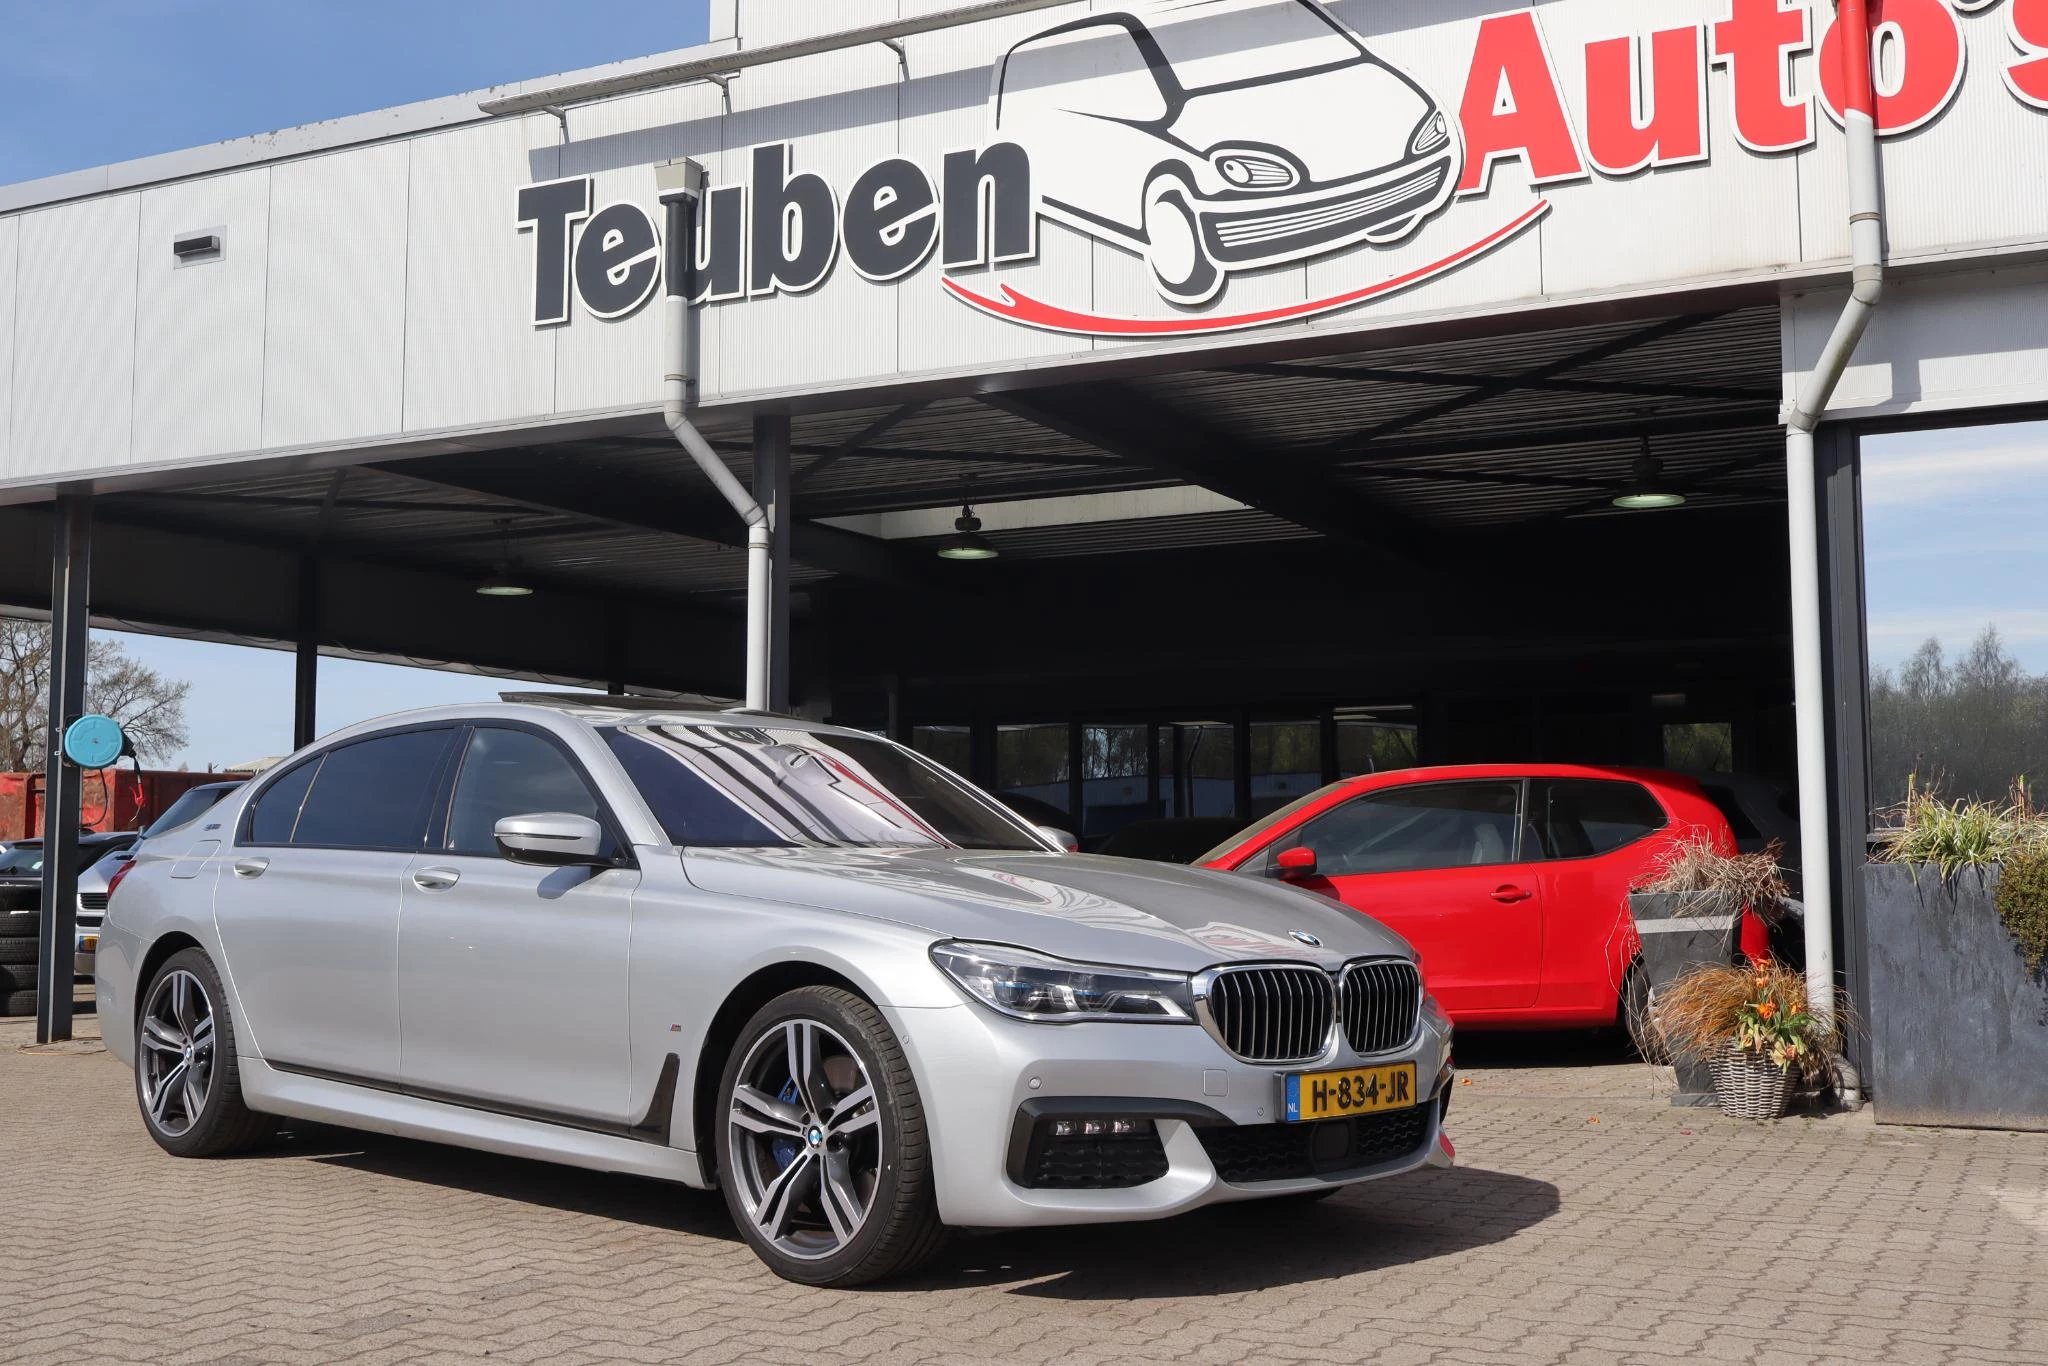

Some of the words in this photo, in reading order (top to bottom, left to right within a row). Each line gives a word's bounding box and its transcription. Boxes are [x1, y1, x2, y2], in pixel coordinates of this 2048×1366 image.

[517, 141, 1031, 322] Teuben
[1457, 0, 2048, 192] Auto
[1287, 1102, 1299, 1113] NL
[1312, 1071, 1409, 1113] H-834-JR
